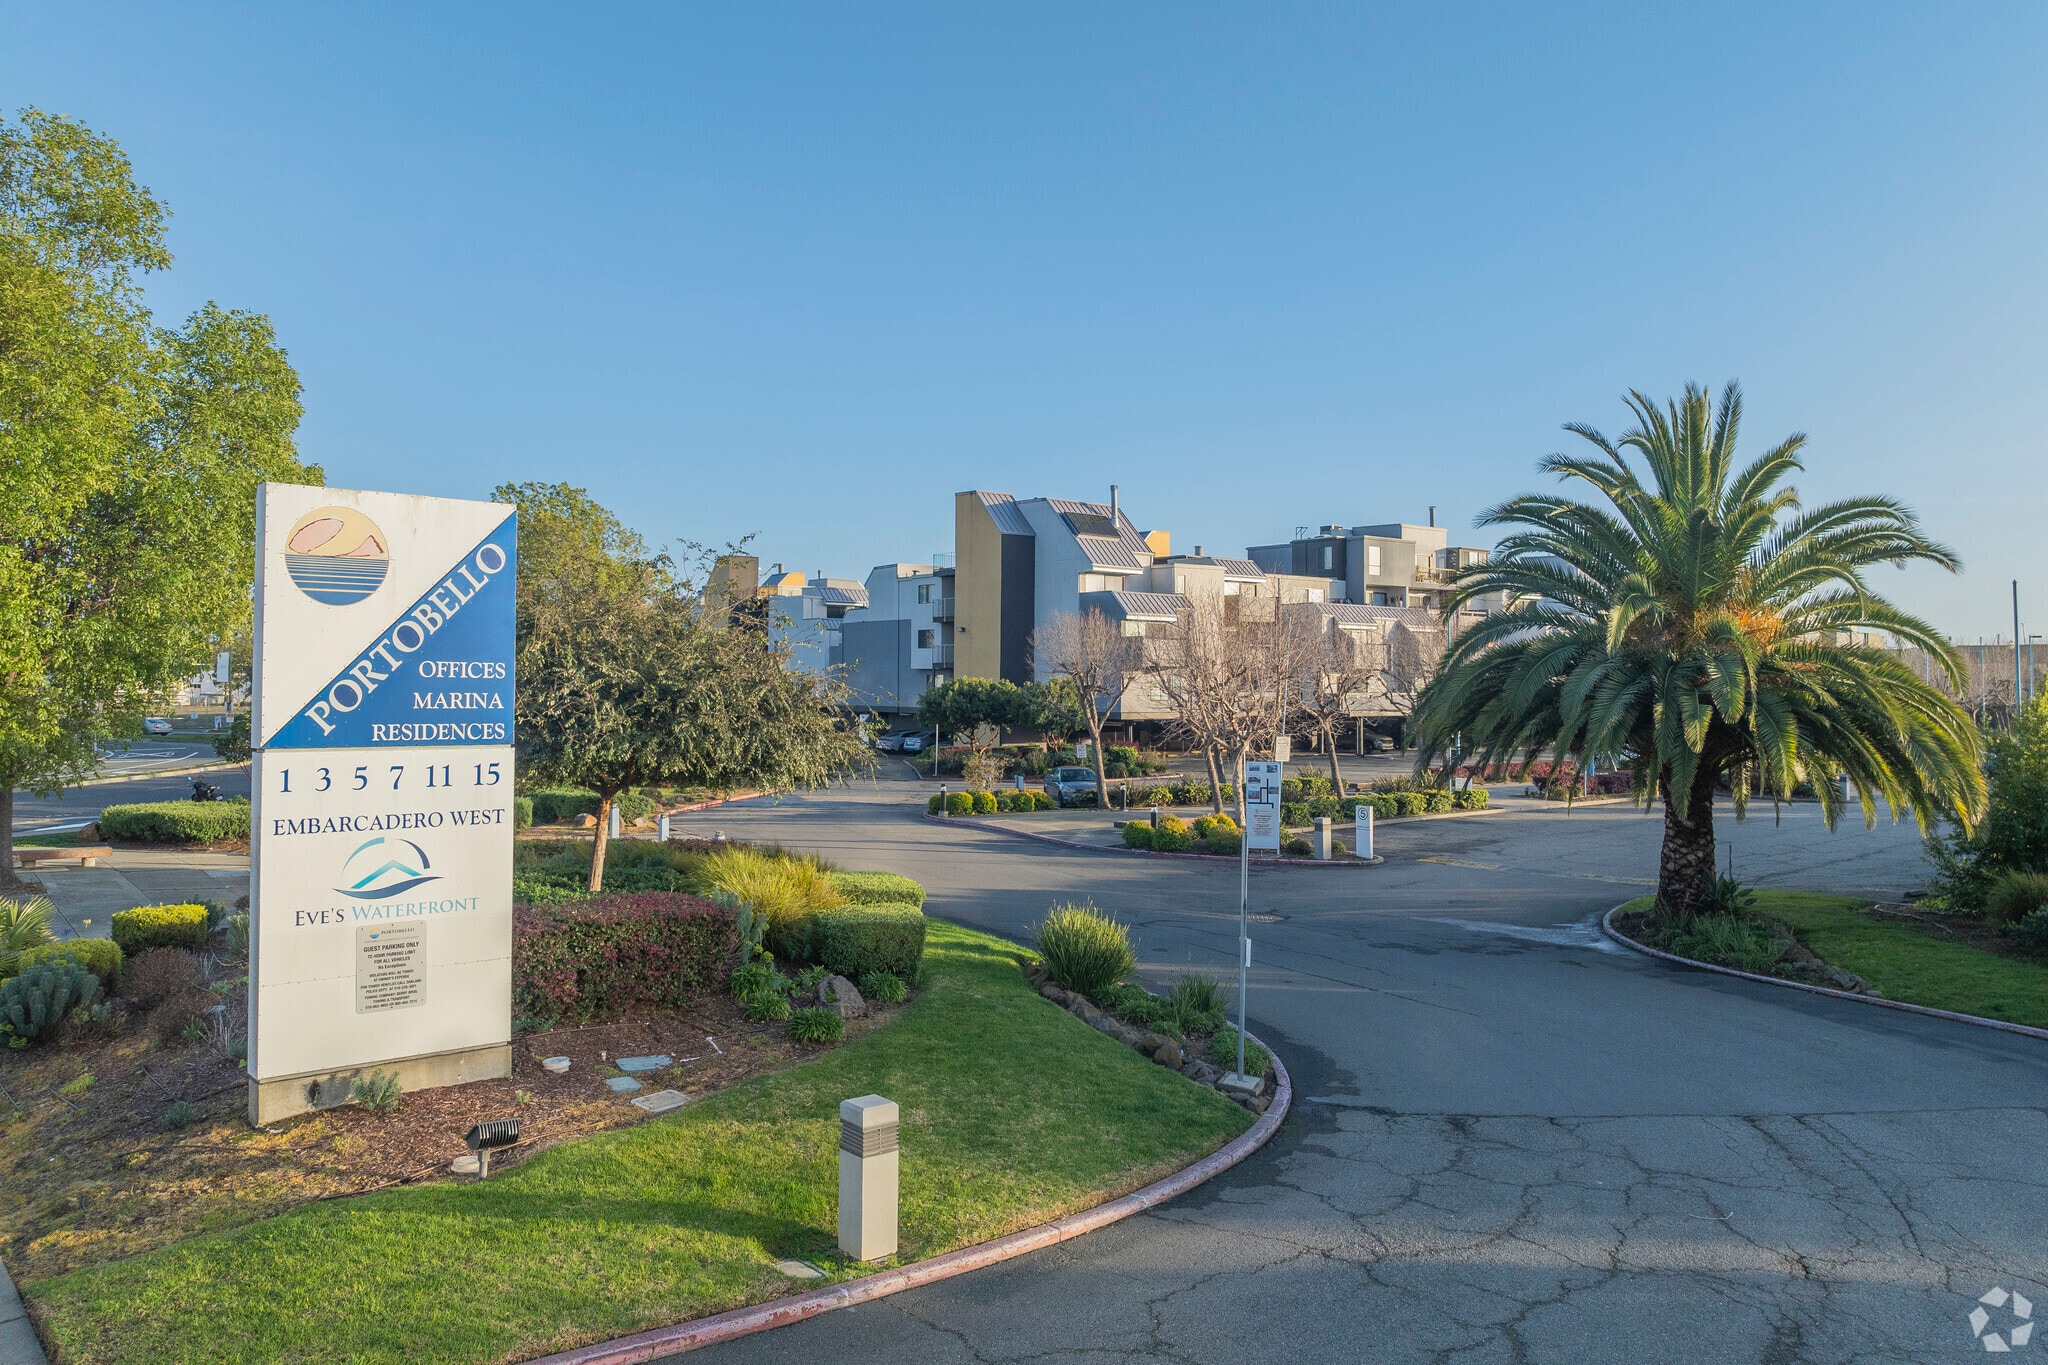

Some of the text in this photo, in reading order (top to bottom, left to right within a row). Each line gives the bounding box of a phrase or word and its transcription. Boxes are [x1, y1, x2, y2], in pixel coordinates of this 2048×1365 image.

[304, 543, 506, 737] PORTOBELLO
[418, 660, 506, 679] OFFICES
[413, 692, 504, 709] MARINA
[371, 722, 505, 742] RESIDENCES
[280, 762, 501, 793] 1 3 5 7 11 15
[273, 808, 505, 836] EMBARCADERO WEST
[295, 897, 480, 927] EVE'S WATERFRONT
